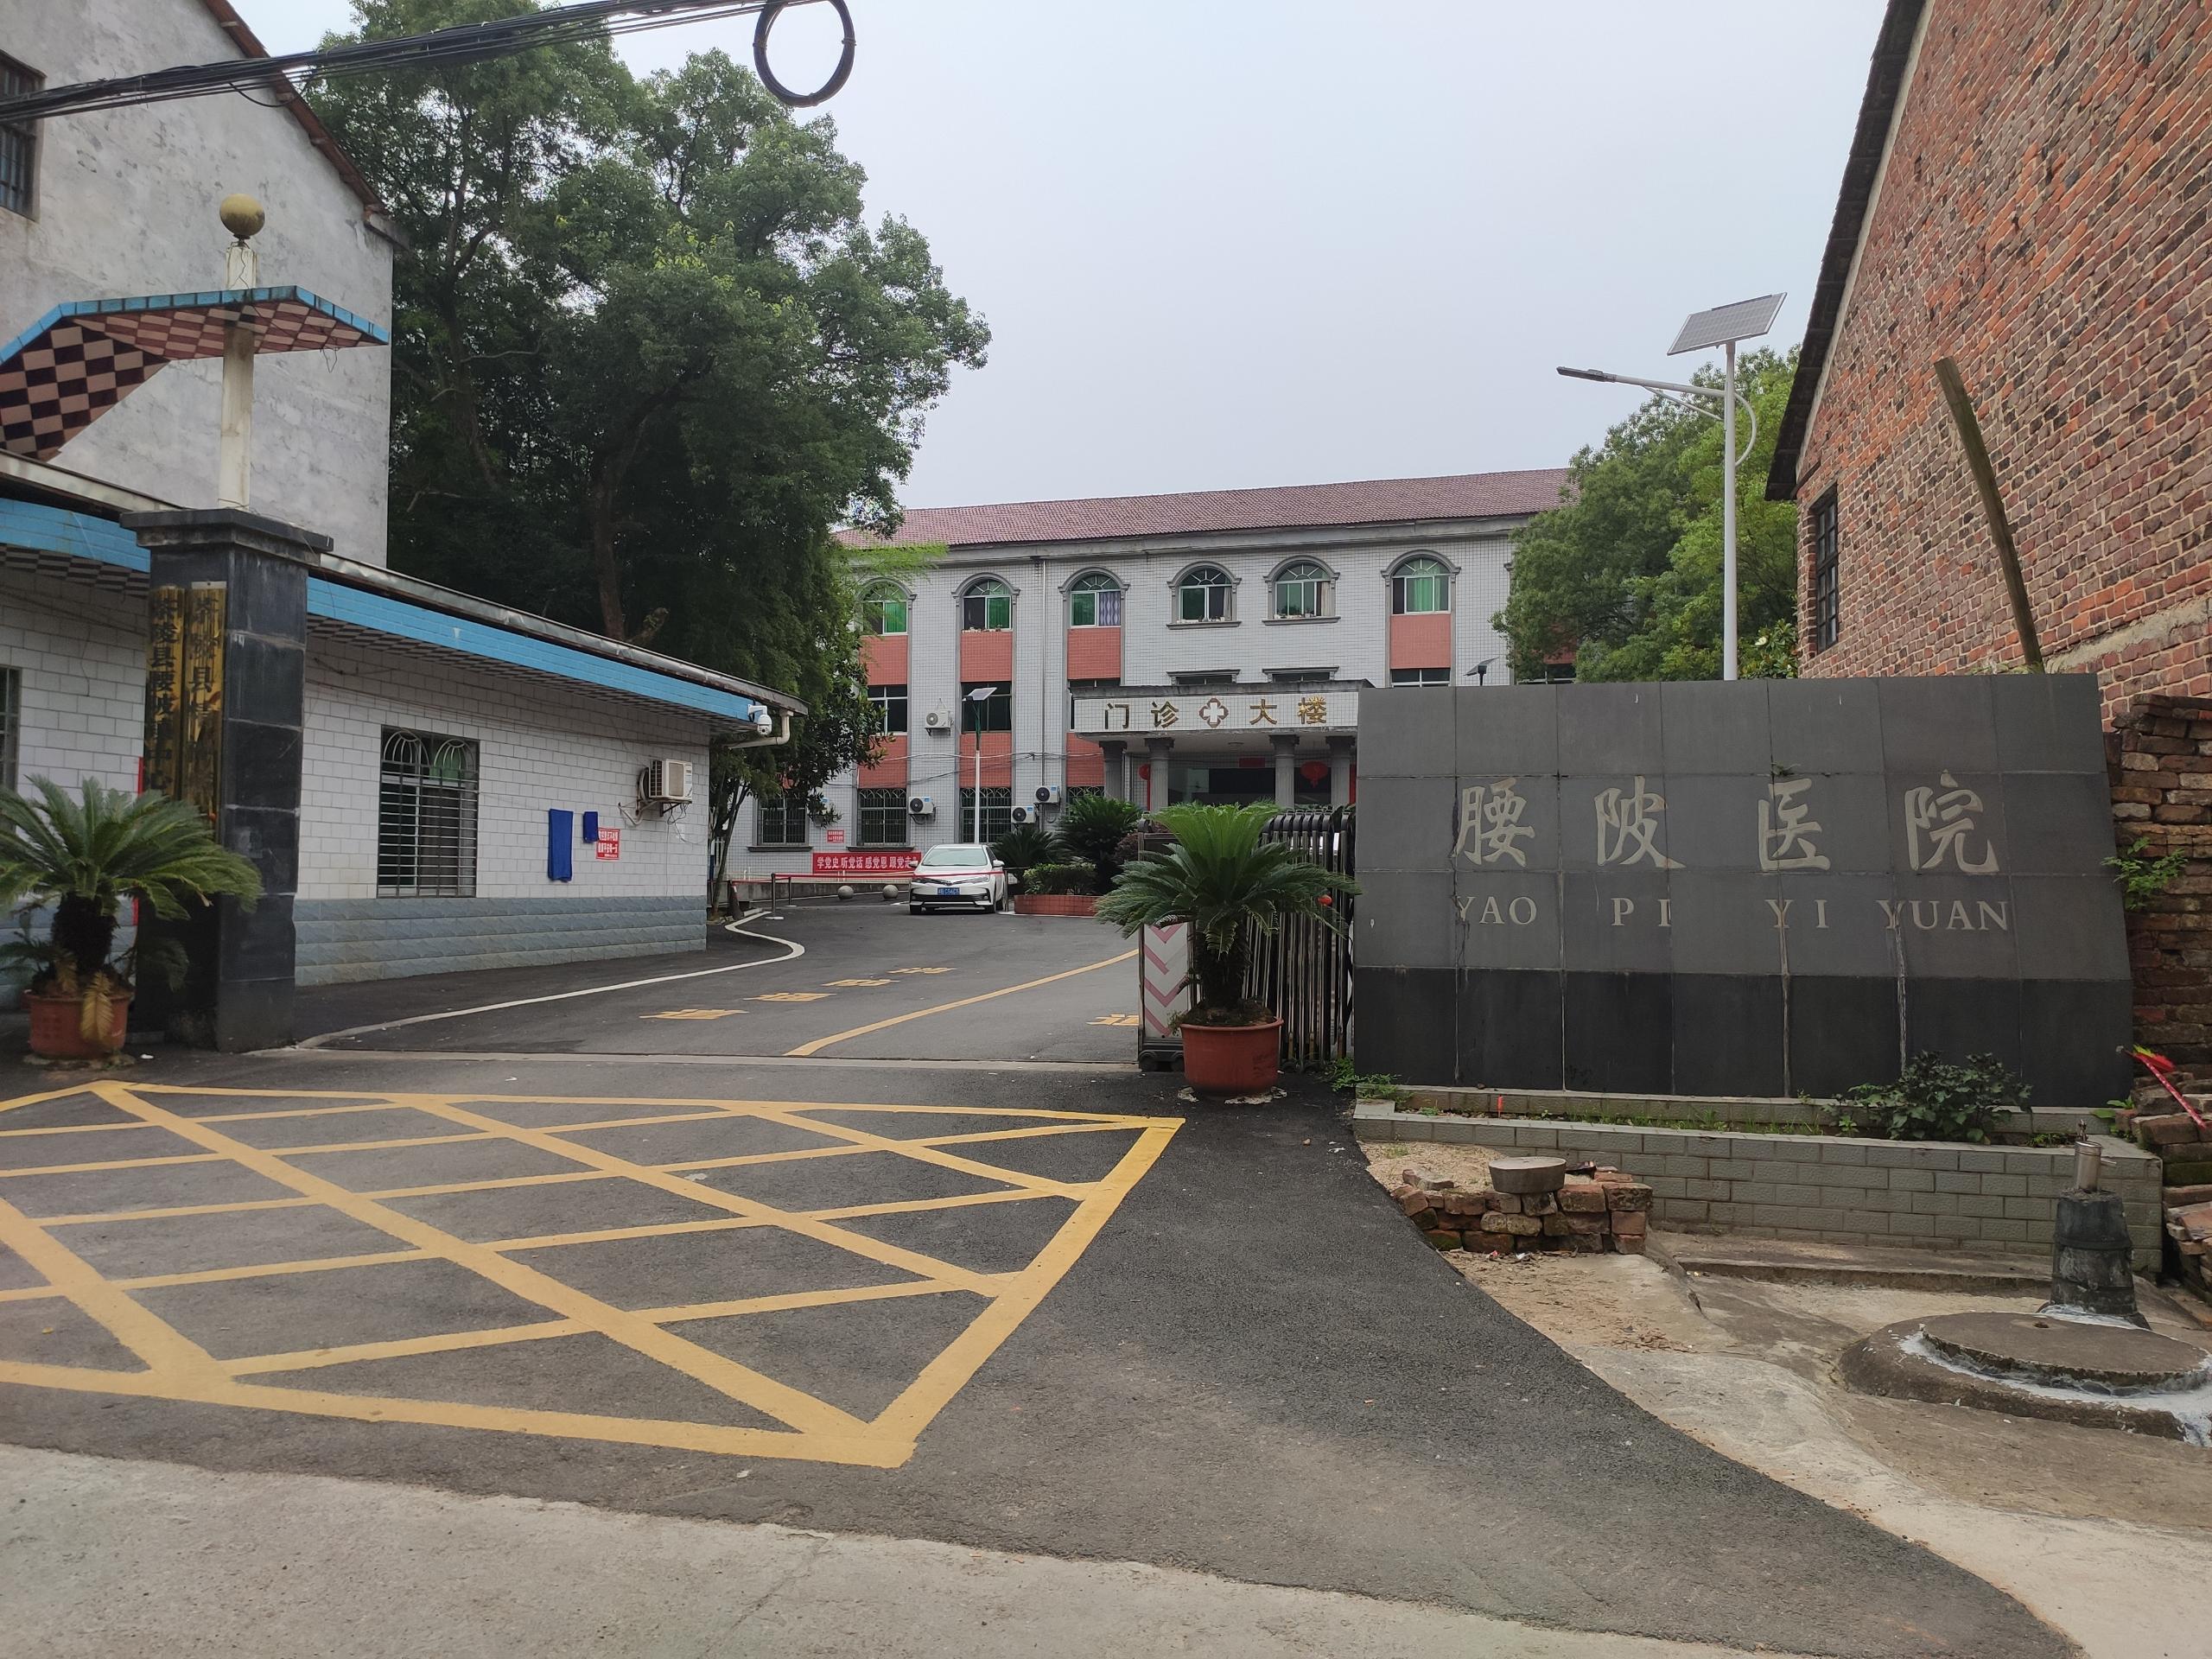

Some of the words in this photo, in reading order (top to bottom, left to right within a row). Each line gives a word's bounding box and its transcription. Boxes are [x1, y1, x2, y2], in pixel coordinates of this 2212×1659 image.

[1104, 696, 1327, 730] 门诊大楼
[1451, 773, 1999, 875] 腰陂医院
[1457, 896, 1537, 925] YAO
[1611, 897, 1672, 927] PI
[1764, 899, 1830, 929] YI
[1875, 899, 2008, 931] YUAN
